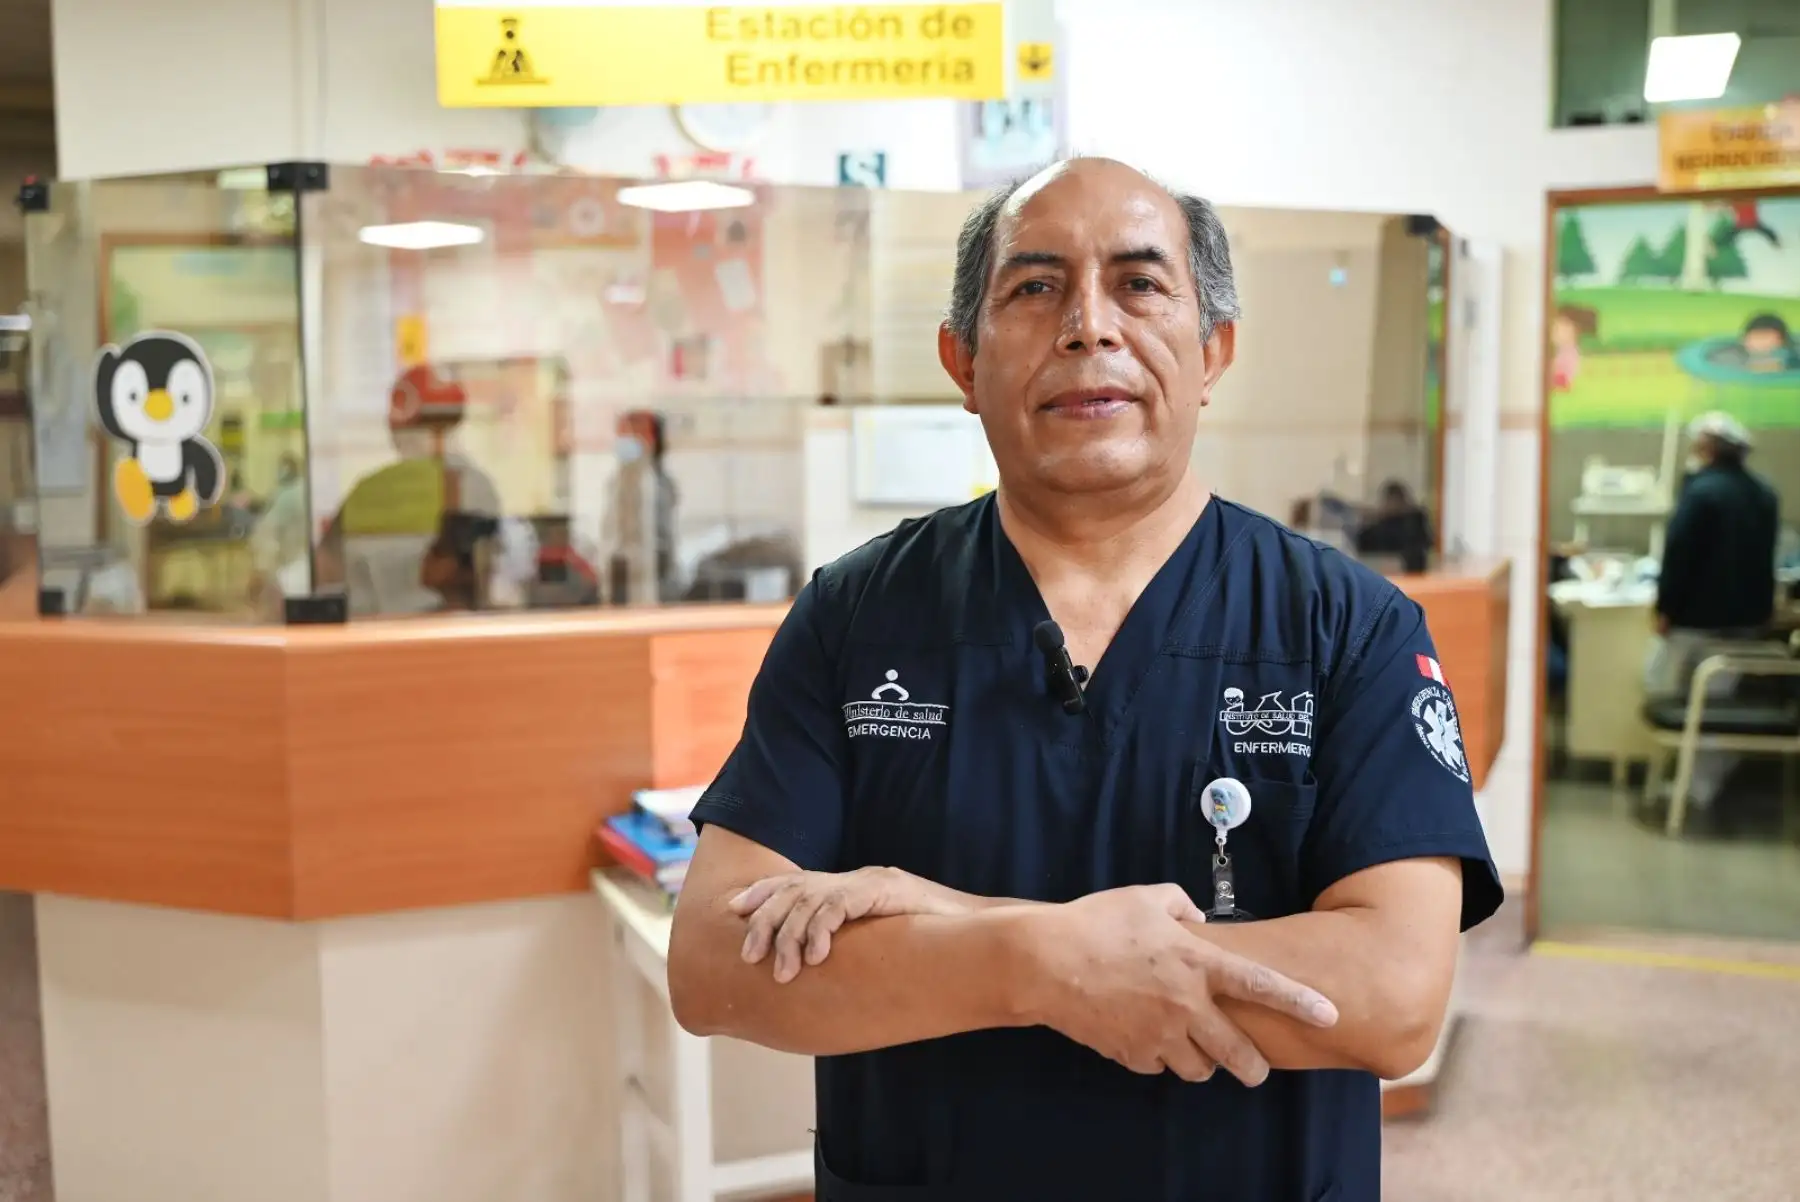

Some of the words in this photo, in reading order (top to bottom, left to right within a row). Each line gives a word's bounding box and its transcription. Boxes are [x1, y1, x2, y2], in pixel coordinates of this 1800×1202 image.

[705, 7, 903, 41] Estación
[919, 8, 975, 41] de
[895, 706, 910, 719] de
[912, 708, 943, 721] salud
[847, 723, 932, 740] EMERGENCIA
